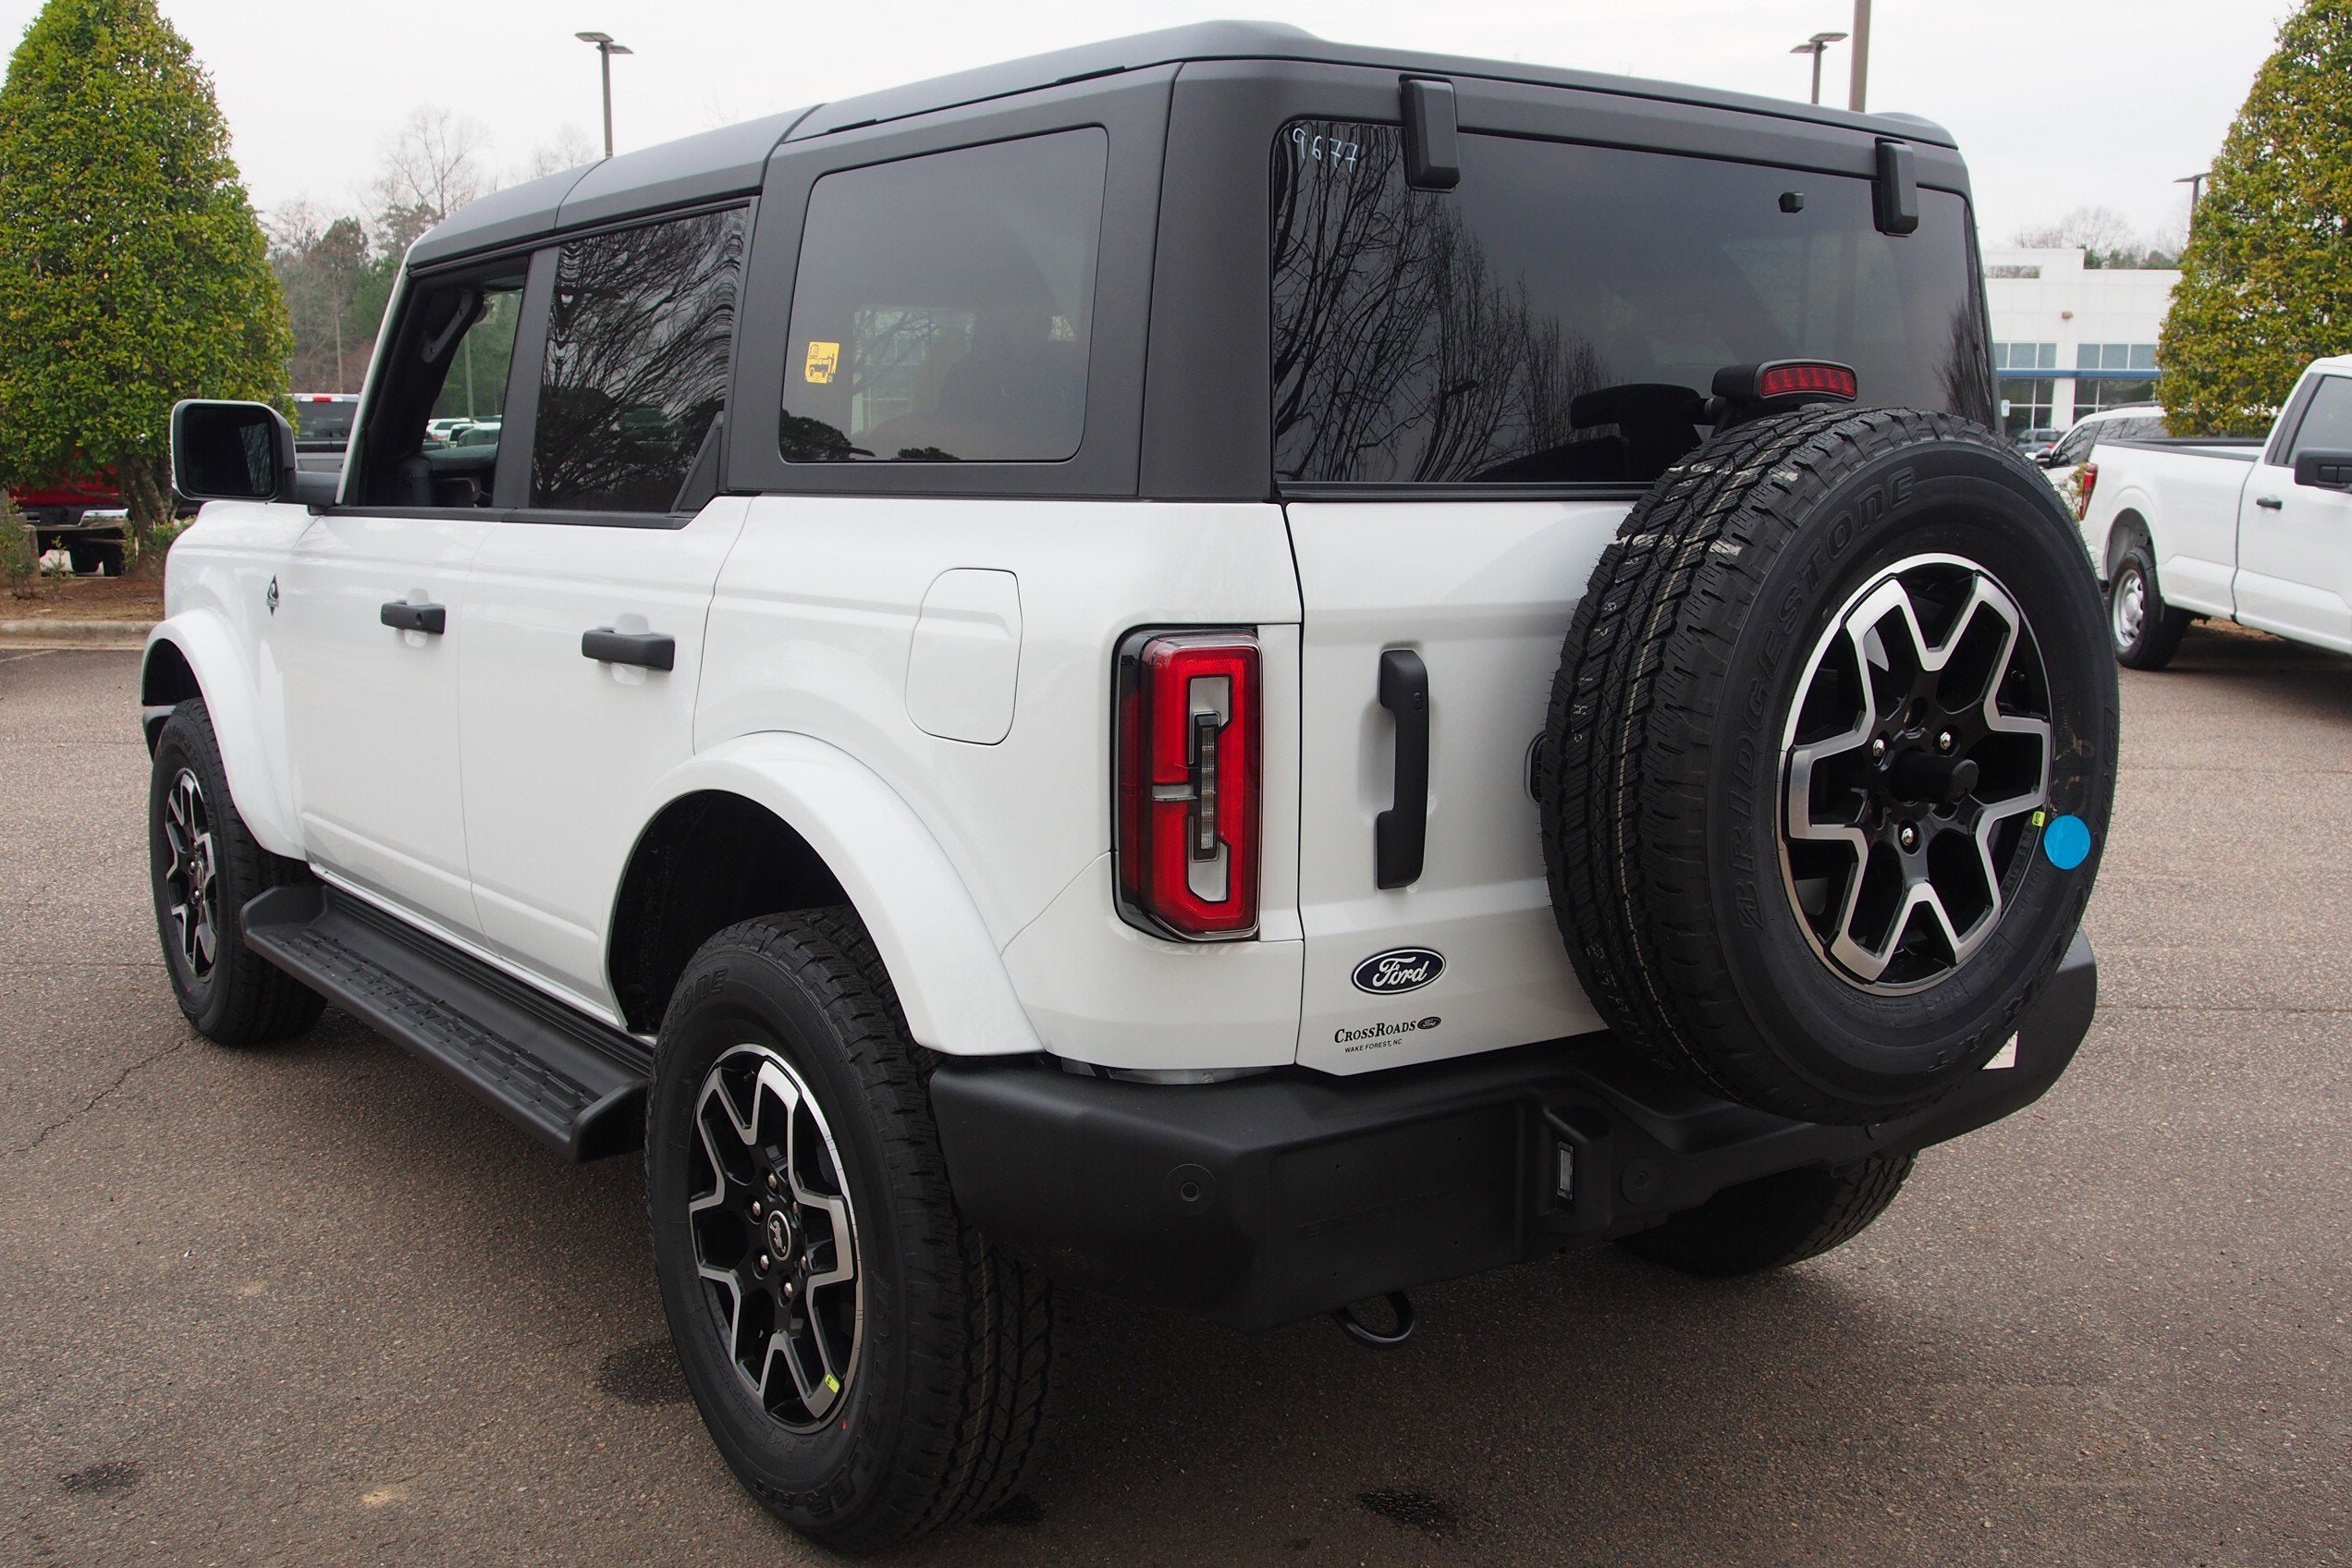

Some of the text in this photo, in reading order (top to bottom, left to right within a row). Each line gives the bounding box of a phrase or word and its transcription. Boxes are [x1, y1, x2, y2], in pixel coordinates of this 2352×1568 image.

[1292, 127, 1359, 174] 9677
[1729, 465, 1917, 931] BRIDGESTONE
[1371, 955, 1430, 988] Ford
[1344, 1038, 1403, 1054] WAKE FOREST, NC
